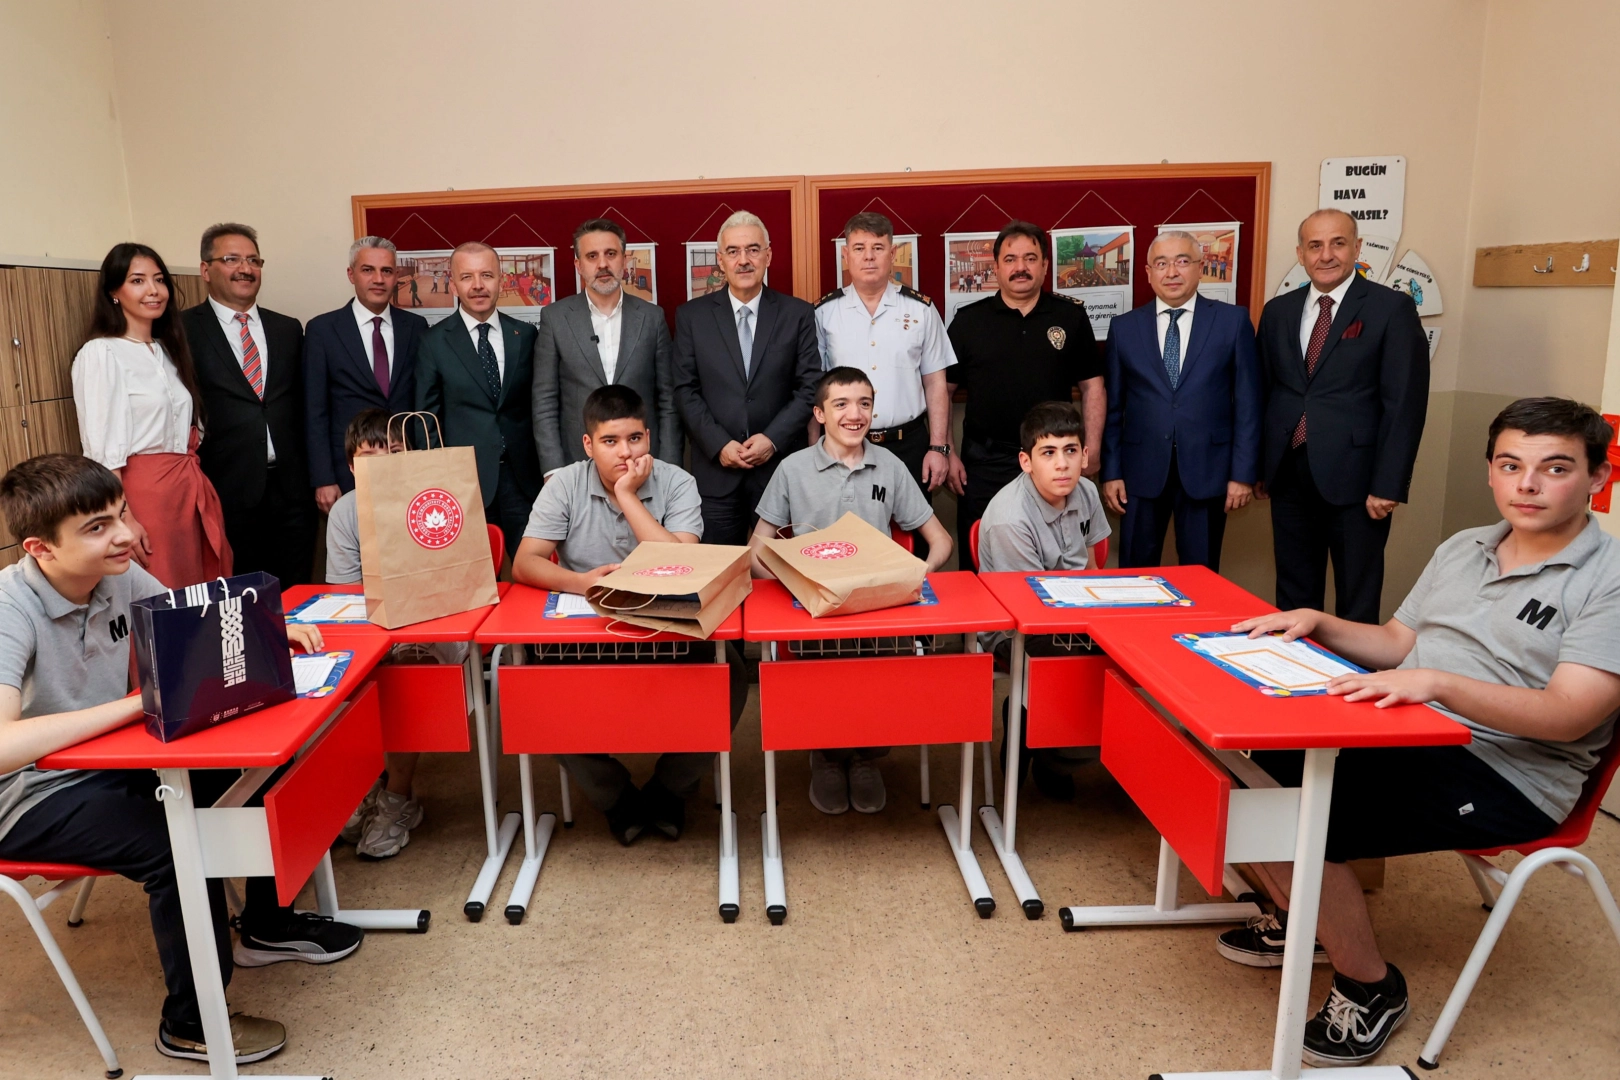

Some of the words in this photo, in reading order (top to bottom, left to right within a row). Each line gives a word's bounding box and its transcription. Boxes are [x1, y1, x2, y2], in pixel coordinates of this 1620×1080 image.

[1345, 163, 1387, 176] BUGÜN
[1334, 189, 1366, 200] HAVA
[1088, 302, 1117, 311] oynamak
[872, 484, 886, 503] M
[1080, 519, 1090, 537] M
[1516, 598, 1558, 631] M
[109, 614, 129, 643] M
